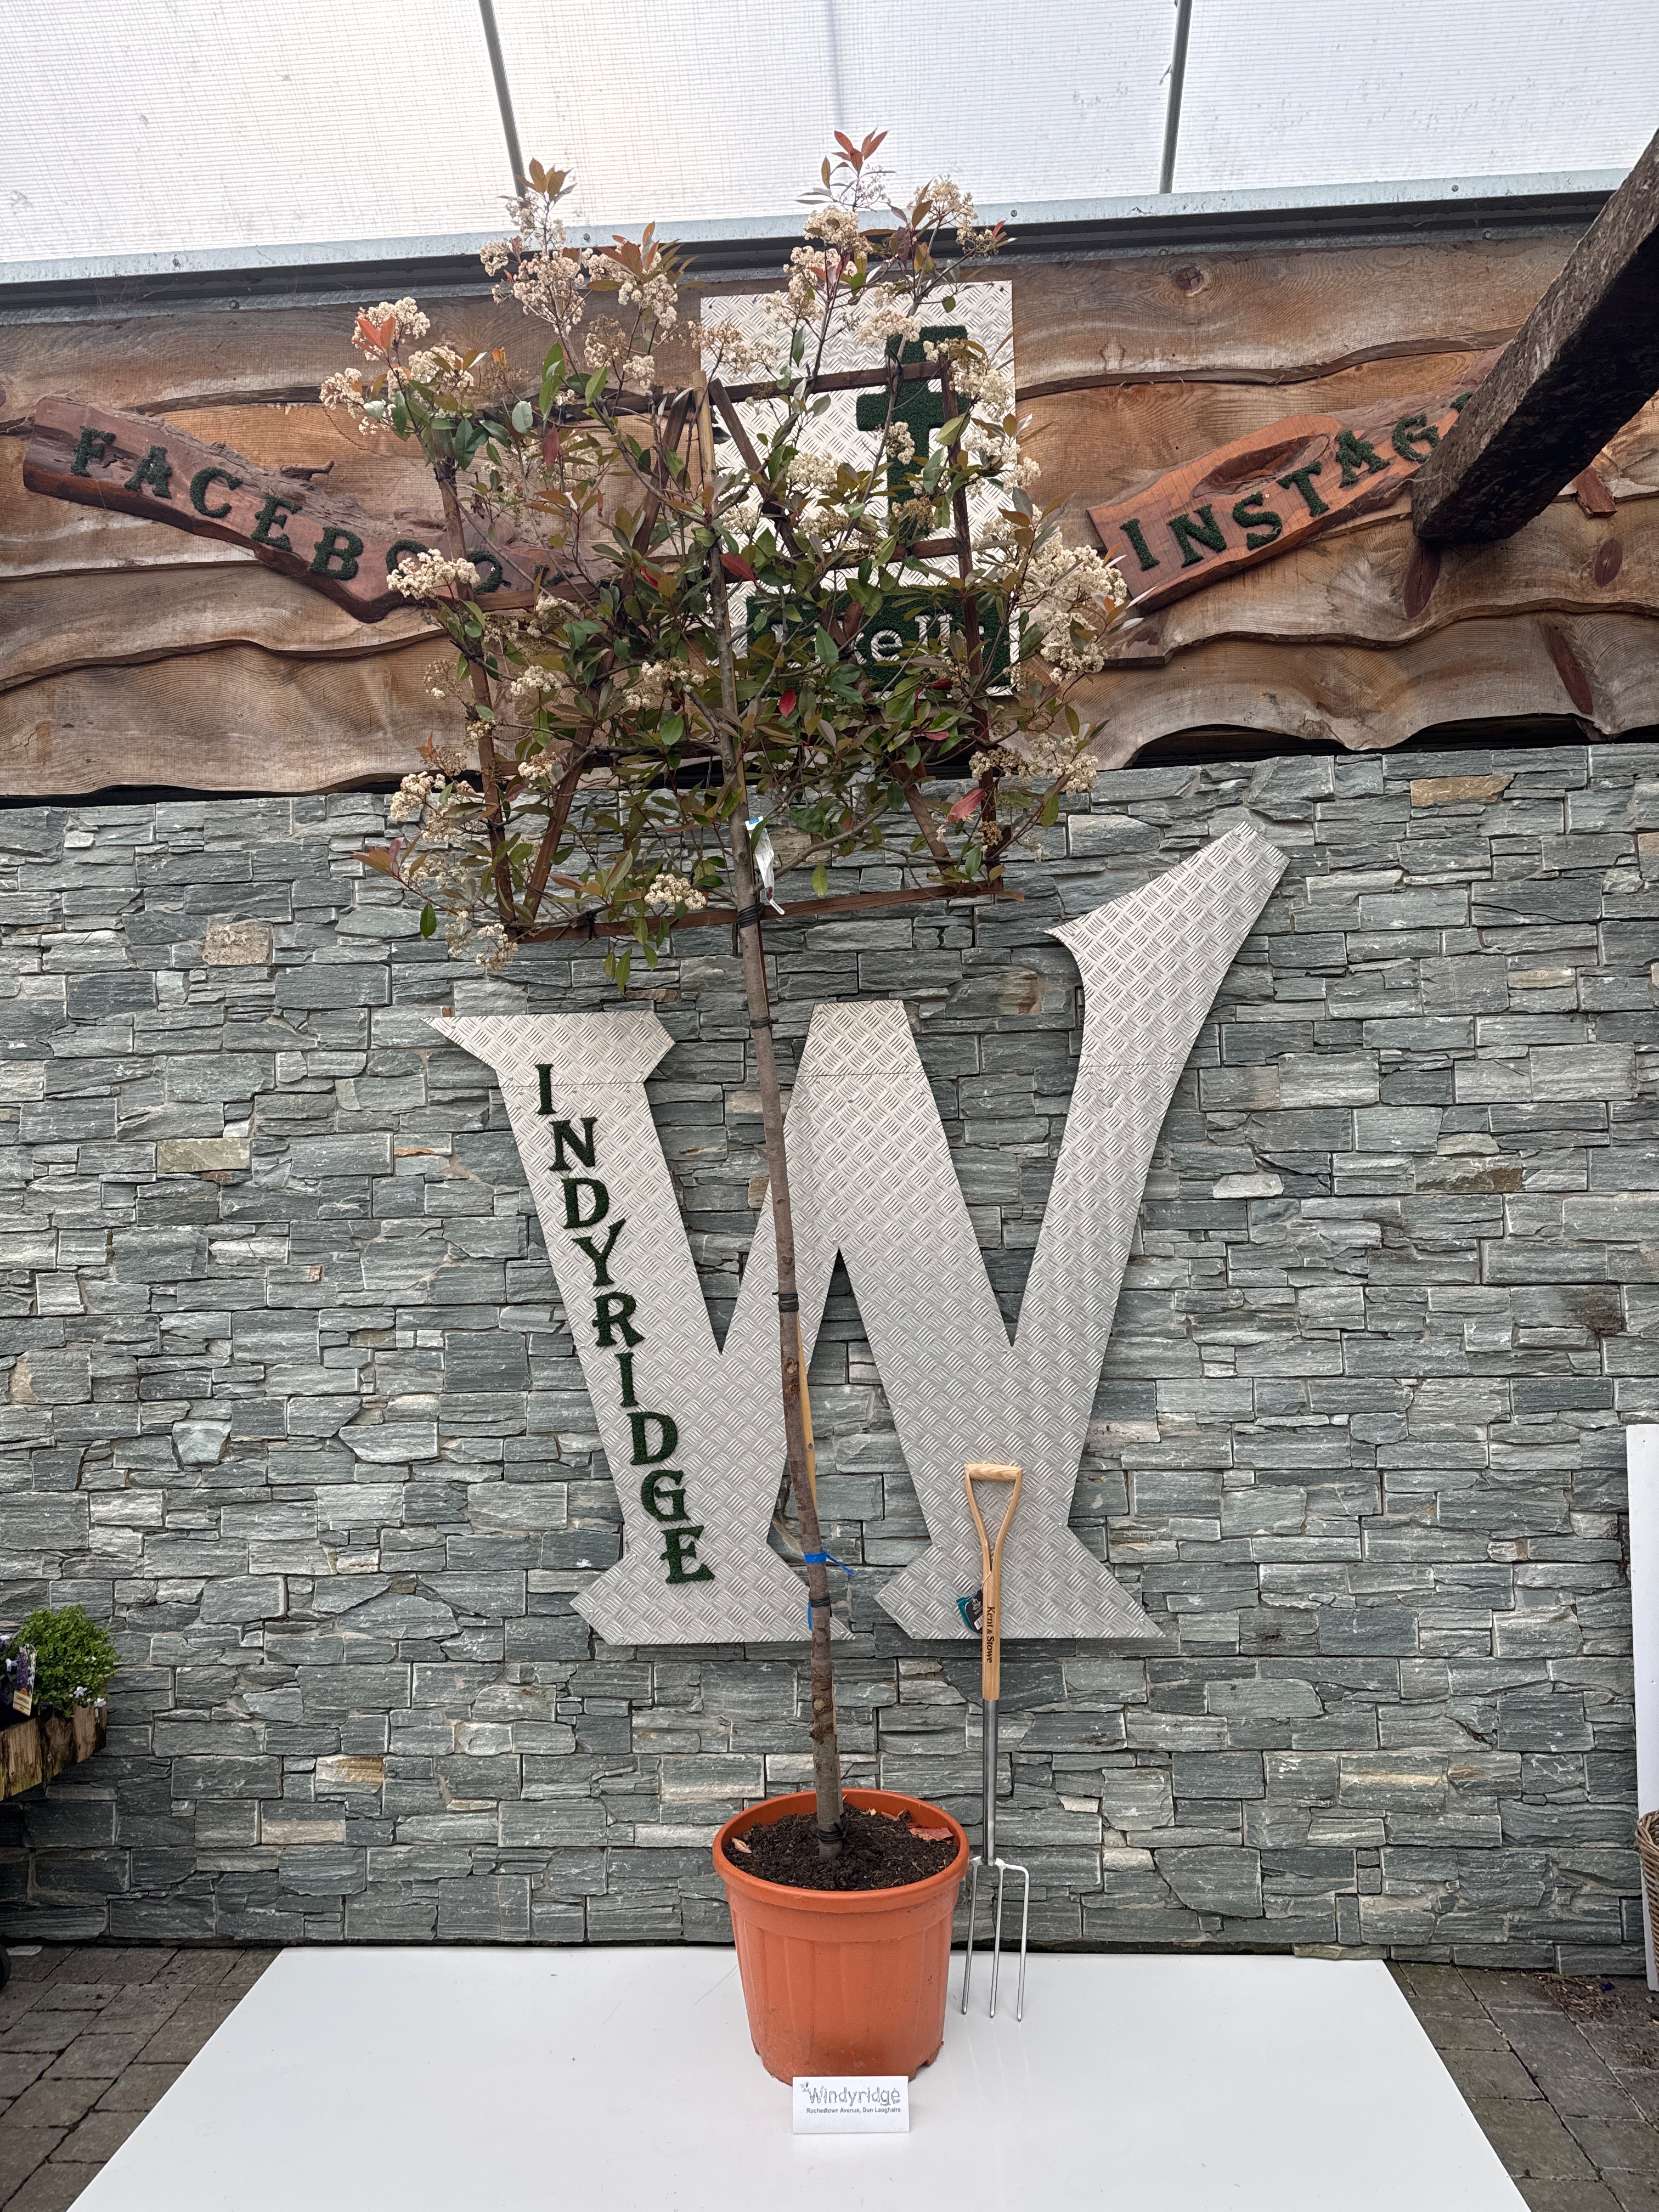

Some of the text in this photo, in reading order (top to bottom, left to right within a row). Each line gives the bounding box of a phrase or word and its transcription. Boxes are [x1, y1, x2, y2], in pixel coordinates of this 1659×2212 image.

[1119, 391, 1475, 572] INSTAG
[534, 1063, 715, 1584] INDYRIDGE
[987, 1606, 995, 1628] Kent
[986, 1635, 995, 1663] Stowe
[806, 2086, 900, 2107] Windyridge
